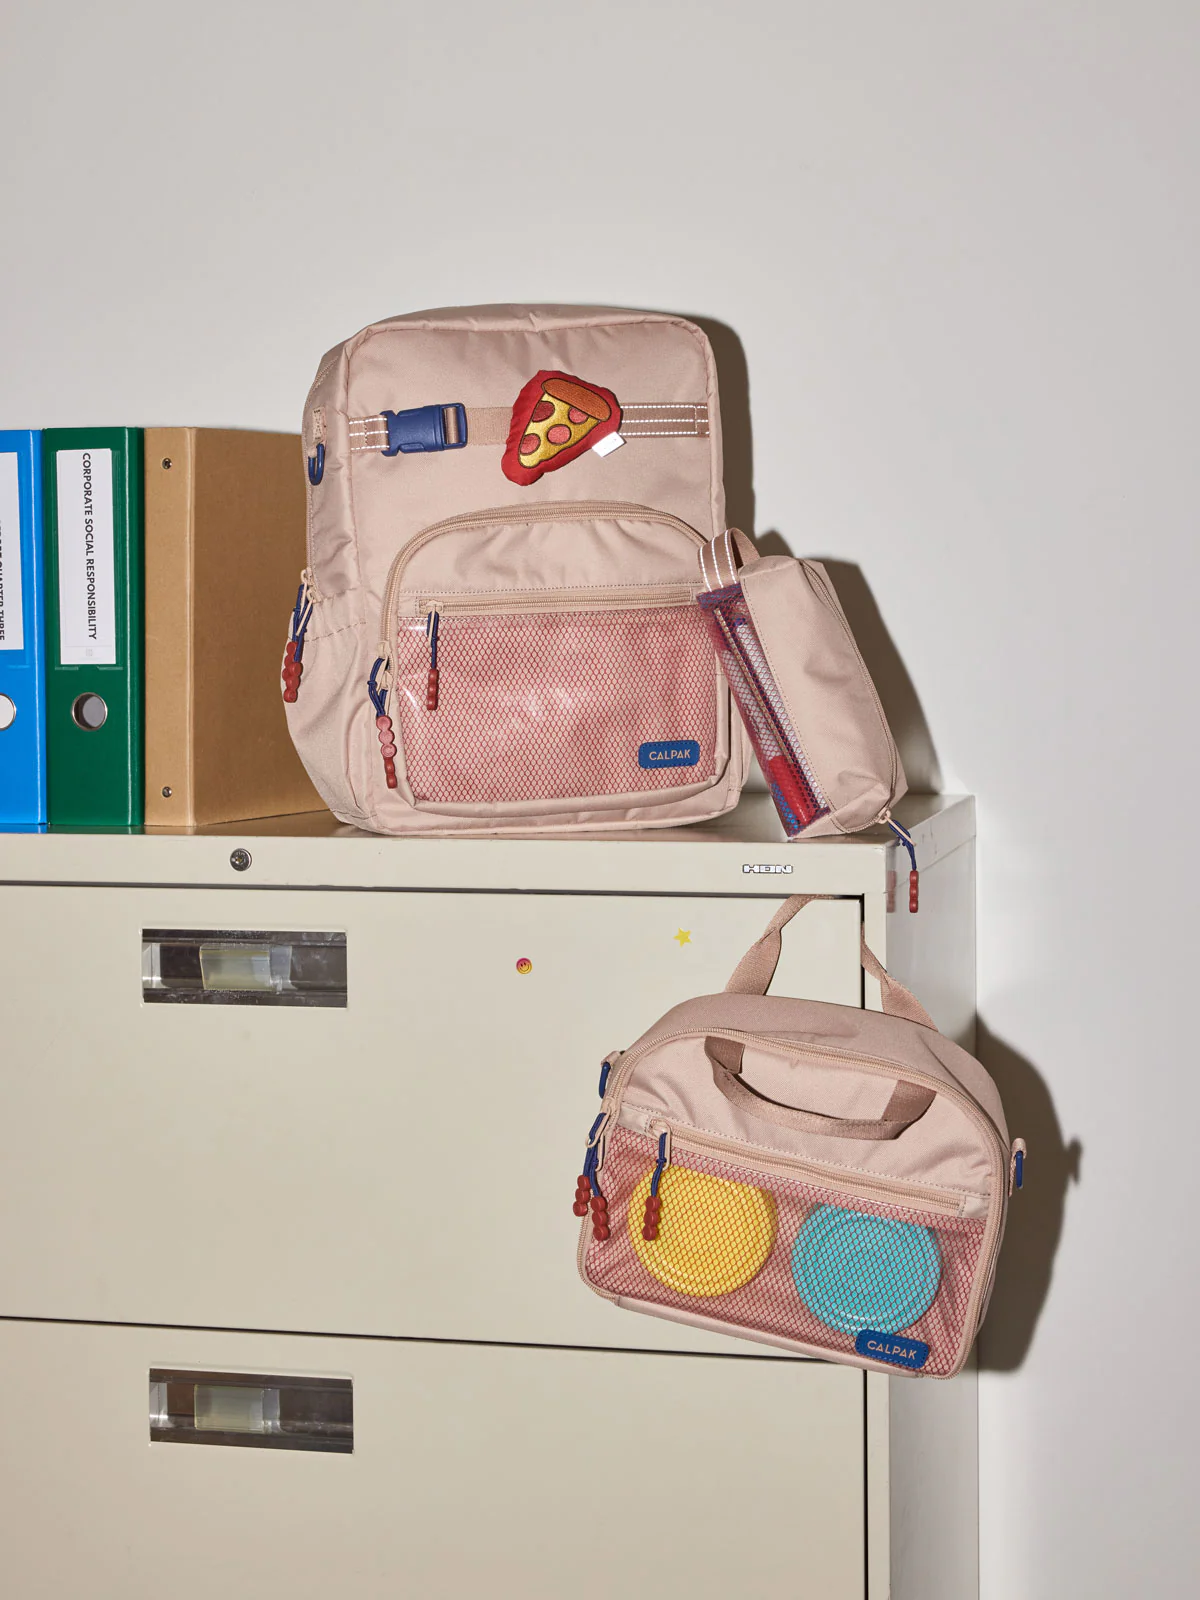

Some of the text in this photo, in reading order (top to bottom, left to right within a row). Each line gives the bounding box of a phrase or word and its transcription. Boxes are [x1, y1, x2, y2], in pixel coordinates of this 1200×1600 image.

[82, 452, 97, 640] CORPORATE SOCIAL RESPONSIBILITY
[649, 749, 691, 761] CALPAK
[742, 864, 793, 874] HON
[867, 1340, 917, 1360] CALPAK
